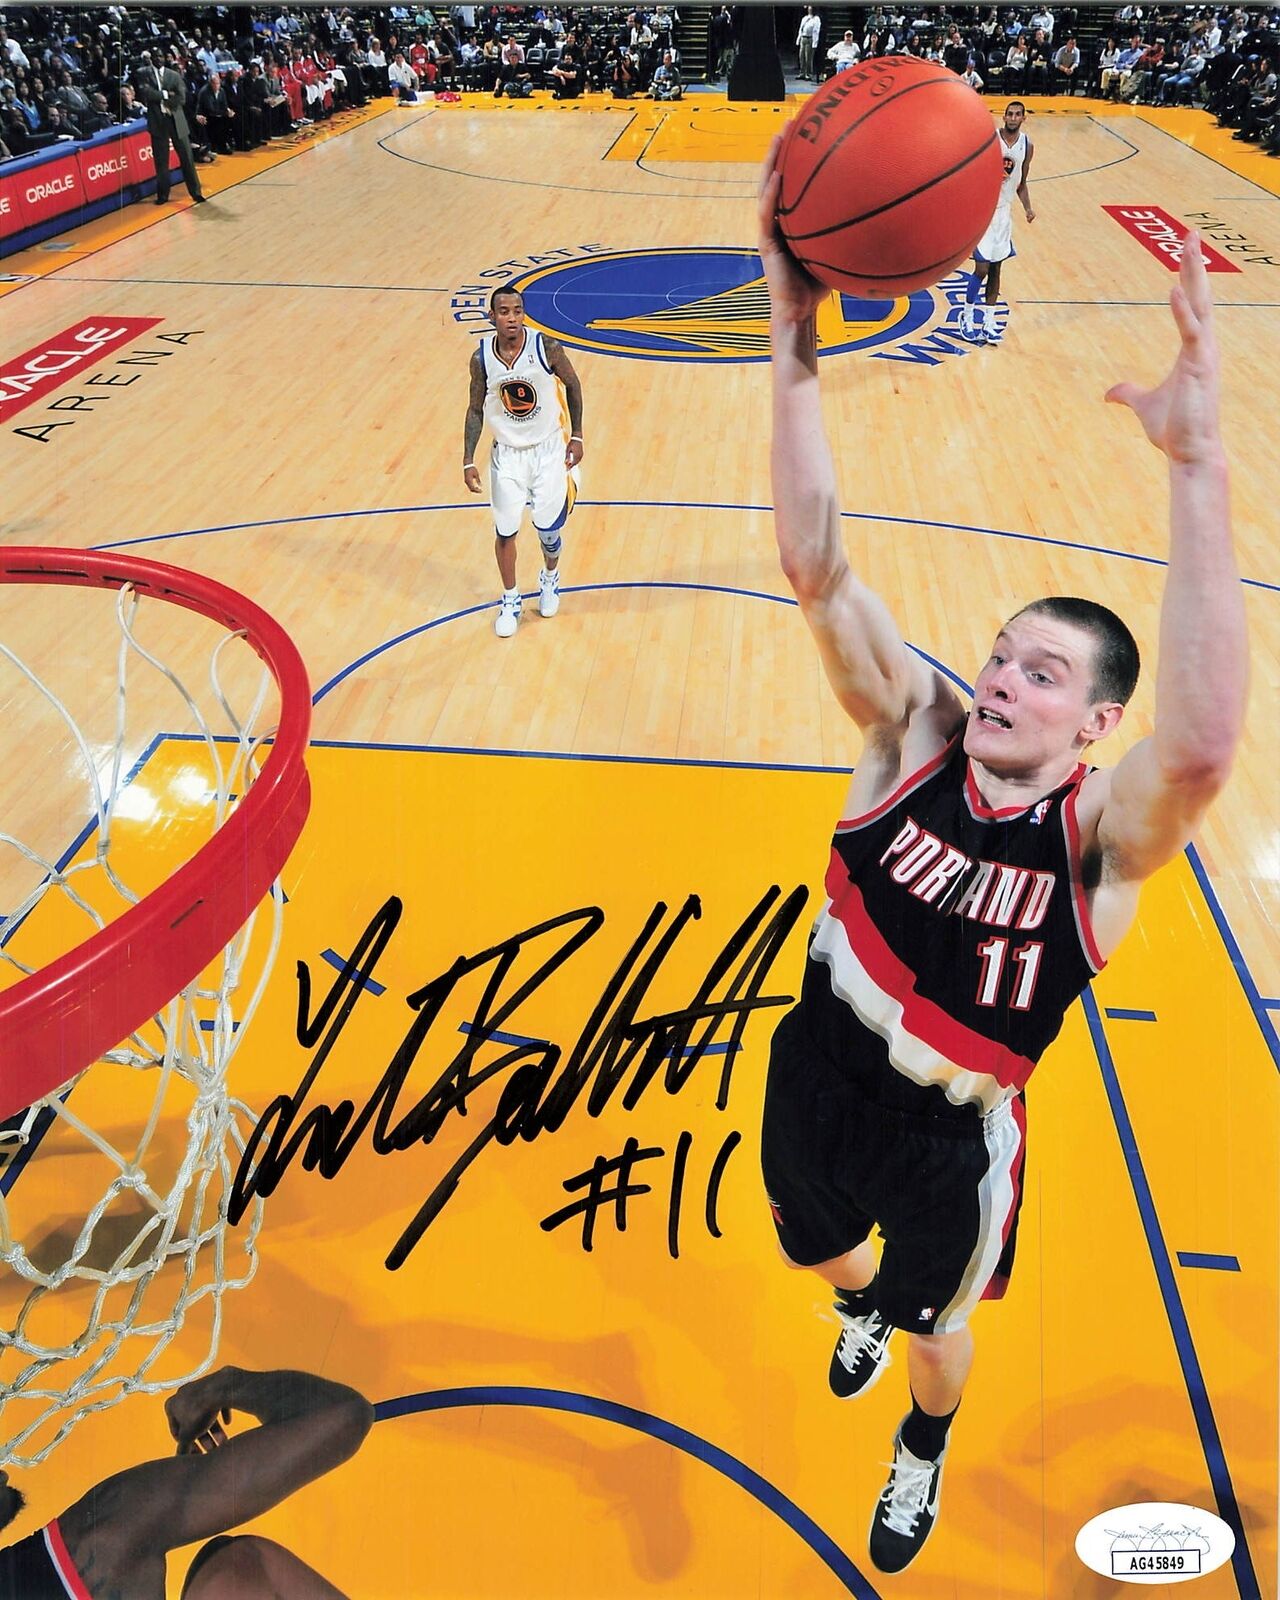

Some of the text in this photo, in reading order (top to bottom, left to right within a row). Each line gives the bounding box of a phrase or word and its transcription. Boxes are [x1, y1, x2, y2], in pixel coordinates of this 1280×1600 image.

[87, 155, 128, 181] ORACLE
[25, 174, 74, 204] ORACLE
[1183, 211, 1280, 266] ARENA
[480, 243, 614, 279] STATE
[12, 330, 205, 443] ARENA
[517, 387, 526, 398] 8
[975, 936, 1045, 1011] 11
[1130, 1556, 1185, 1570] AG45849
